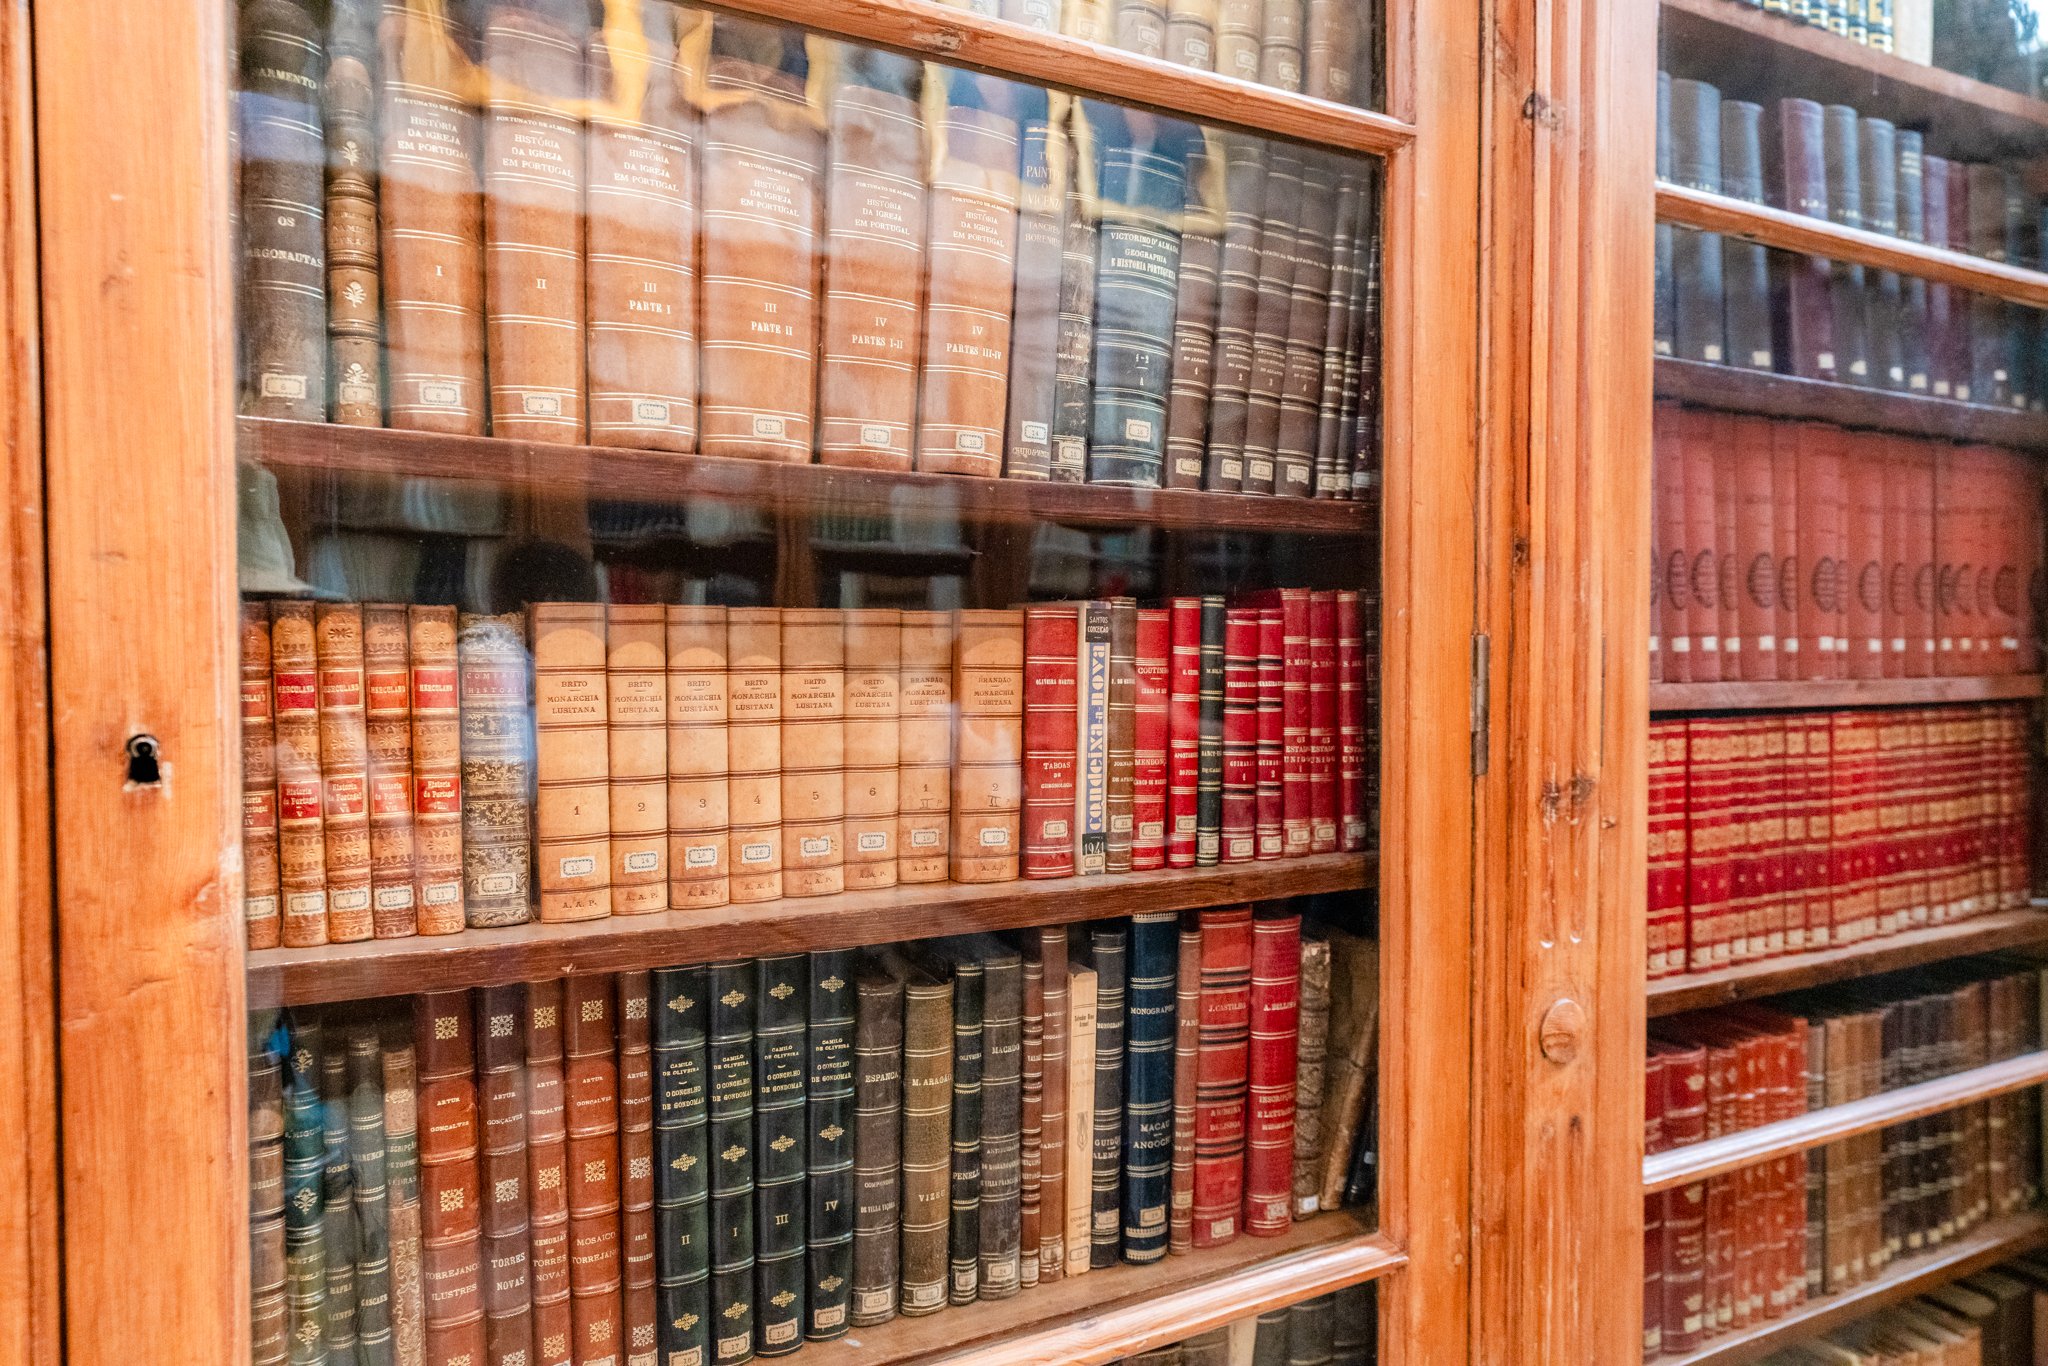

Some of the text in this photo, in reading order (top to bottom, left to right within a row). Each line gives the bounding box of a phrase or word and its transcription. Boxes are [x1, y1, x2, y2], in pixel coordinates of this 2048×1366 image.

[410, 115, 457, 133] HISTÓRIA
[407, 129, 461, 146] DA IGREJA
[514, 131, 560, 150] HISTÓRIA
[397, 140, 415, 150] EM
[511, 147, 563, 162] DA IGREJA
[629, 148, 669, 164] HISTÓRIA
[502, 158, 574, 178] EM PORTUGAL
[624, 161, 671, 178] DA IGREJA
[614, 172, 679, 192] EM PORTUGAL
[754, 178, 791, 194] HISTÓRIA
[750, 189, 792, 205] DA IGREJA
[740, 197, 800, 217] EM PORTUGAL
[867, 198, 902, 211] HISTÓRIA
[862, 207, 903, 222] DA IGREJA
[965, 210, 998, 225] HISTÓRIA
[277, 215, 295, 227] OS
[855, 218, 911, 235] EM PORTUGAL
[960, 220, 998, 235] DA IGREJA
[953, 231, 1005, 248] EM PORTUGAL
[1111, 232, 1151, 245] VICTORINO
[1125, 248, 1167, 264] GEOGRAPHIA
[1116, 258, 1147, 271] HISTORIA
[435, 265, 443, 277] I
[536, 278, 547, 289] II
[644, 282, 657, 293] III
[629, 300, 672, 315] PARTE I
[764, 302, 777, 313] III
[875, 317, 887, 327] IV
[751, 321, 793, 336] PARTE II
[972, 325, 984, 335] IV
[852, 334, 903, 349] PARTES I-II
[946, 343, 979, 357] PARTES
[1089, 616, 1109, 624] SANTOS
[1087, 625, 1109, 634] CONCEIÇÃO
[910, 676, 943, 684] BRANDÃO
[277, 683, 314, 694] HERCULANO
[370, 685, 406, 694] HERCULANO
[419, 683, 453, 692] HERCULANO
[547, 695, 599, 703] MONARCHIA
[614, 695, 663, 703] MONARCHIA
[731, 692, 777, 700] MONARCHIA
[791, 692, 836, 700] MONARCHIA
[735, 703, 774, 711] LUSITANA
[1089, 645, 1105, 830] condeixa-a-nova
[1043, 762, 1071, 770] TABOAS
[869, 787, 877, 797] 6
[923, 784, 928, 792] 1
[992, 783, 999, 792] 2
[431, 790, 456, 799] Portugal
[753, 795, 761, 805] 4
[812, 791, 820, 801] 5
[638, 803, 646, 812] 2
[699, 799, 707, 808] 3
[574, 806, 580, 816] 1
[772, 1045, 793, 1053] CAMILO
[825, 1043, 850, 1051] OLIVEIRA
[722, 1054, 744, 1062] CAMILO
[773, 1052, 799, 1060] OLIVEIRA
[670, 1061, 693, 1069] CAMILO
[723, 1061, 749, 1069] OLIVEIRA
[822, 1061, 850, 1070] CONCELHO
[627, 1071, 648, 1079] ARTUR
[673, 1067, 699, 1076] OLIVEIRA
[773, 1070, 801, 1081] CONCELHO
[865, 1071, 899, 1083] ESPANCA
[582, 1076, 603, 1084] ARTUR
[822, 1072, 851, 1083] GONDOMAR
[912, 1077, 921, 1087] M.
[536, 1080, 558, 1088] ARTUR
[722, 1078, 750, 1089] CONCELHO
[761, 1081, 802, 1094] DE GONDOMAR
[493, 1091, 516, 1101] ARTUR
[672, 1086, 702, 1097] CONCELHO
[723, 1090, 752, 1102] GONDOMAR
[437, 1097, 460, 1106] ARTUR
[662, 1097, 705, 1111] DE GONDOMAR
[487, 1113, 523, 1125] GONÇALVES
[1140, 1120, 1170, 1132] MACAU
[953, 1170, 980, 1180] PENELL
[918, 1189, 946, 1202] VIZEU
[825, 1200, 838, 1211] IV
[775, 1214, 789, 1225] III
[733, 1227, 738, 1237] I
[534, 1231, 567, 1246] MEMORIAS
[576, 1232, 616, 1247] MOSAICO
[681, 1235, 690, 1245] II
[491, 1252, 526, 1268] TORRES
[533, 1254, 567, 1267] TORRES
[536, 1269, 566, 1281] NOVAS
[496, 1277, 525, 1291] NOVAS
[432, 1283, 477, 1301] ILUSTRES
